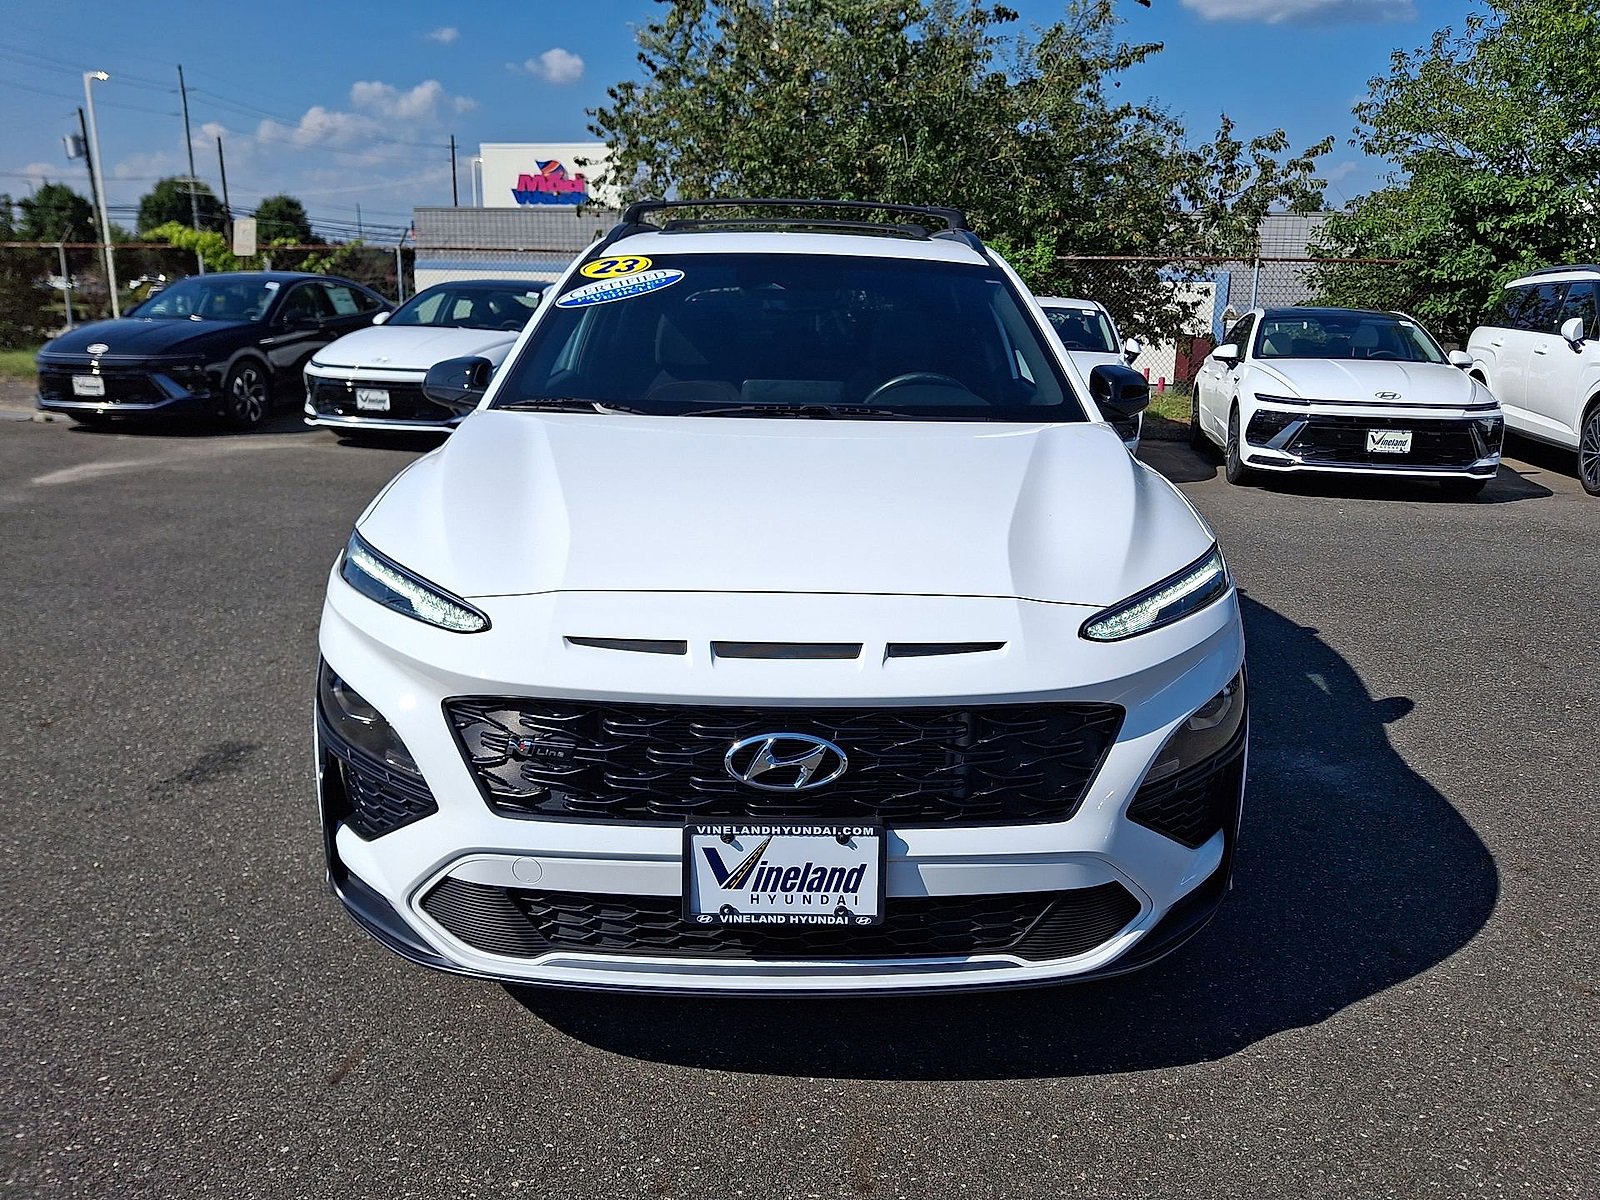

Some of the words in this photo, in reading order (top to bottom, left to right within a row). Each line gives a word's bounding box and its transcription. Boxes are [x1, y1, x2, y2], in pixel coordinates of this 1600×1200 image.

[591, 258, 640, 275] 23
[569, 270, 667, 299] CERTIFIED
[696, 825, 875, 836] VINELANDHYUNDAI.COM
[701, 835, 868, 894] Vineland
[750, 894, 858, 906] HYUNDAI
[720, 914, 786, 924] VINELAND
[790, 915, 849, 925] HYUNDAI
